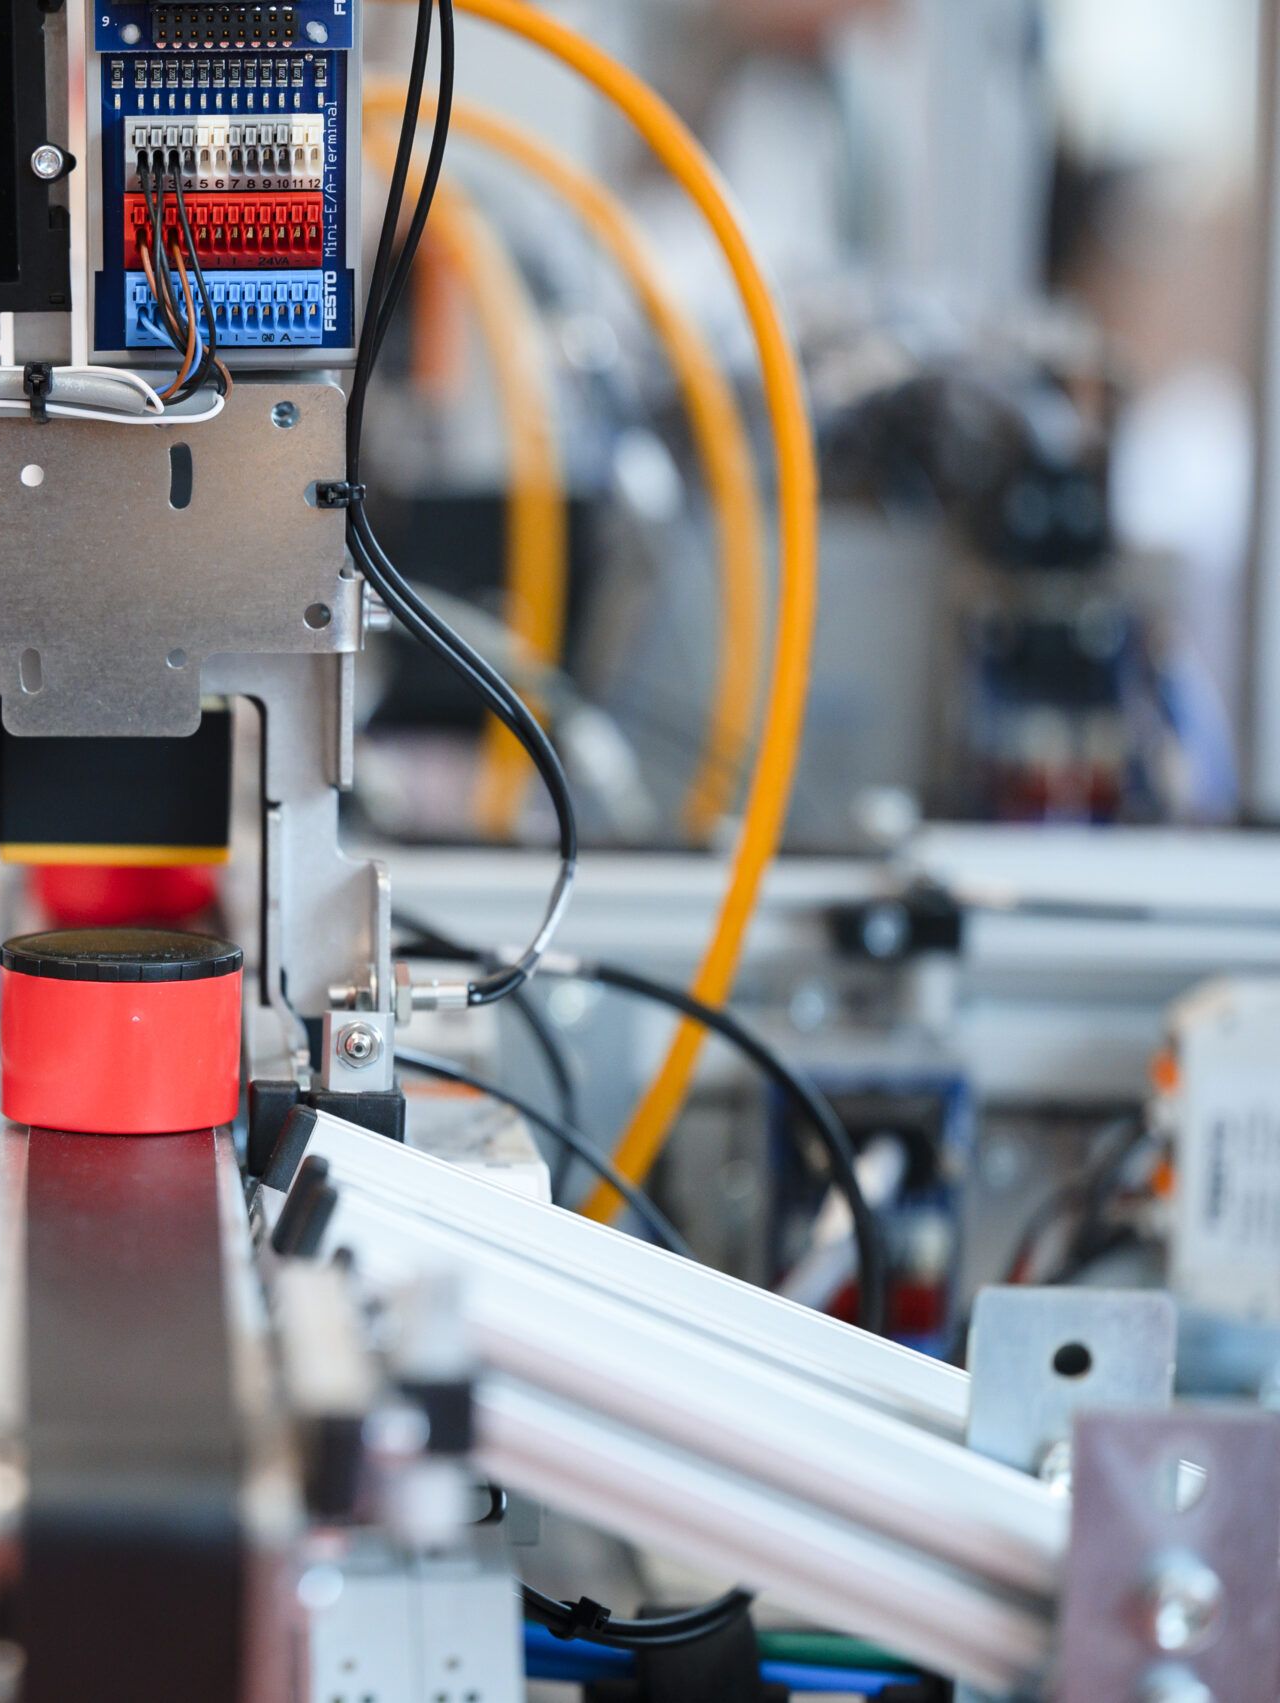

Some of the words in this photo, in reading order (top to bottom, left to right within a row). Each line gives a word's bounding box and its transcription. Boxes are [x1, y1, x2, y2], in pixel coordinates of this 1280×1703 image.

[333, 0, 347, 16] F
[102, 15, 110, 27] 9
[183, 179, 193, 189] 4
[199, 179, 209, 189] 5
[215, 179, 225, 189] 6
[231, 179, 240, 189] 7
[246, 179, 256, 189] 8
[262, 179, 272, 189] 9
[276, 179, 290, 189] 10
[292, 179, 304, 188] 11
[308, 178, 321, 188] 12
[324, 100, 338, 257] Mini-E/A-Terminal
[324, 270, 337, 332] FESTO
[279, 332, 292, 342] A
